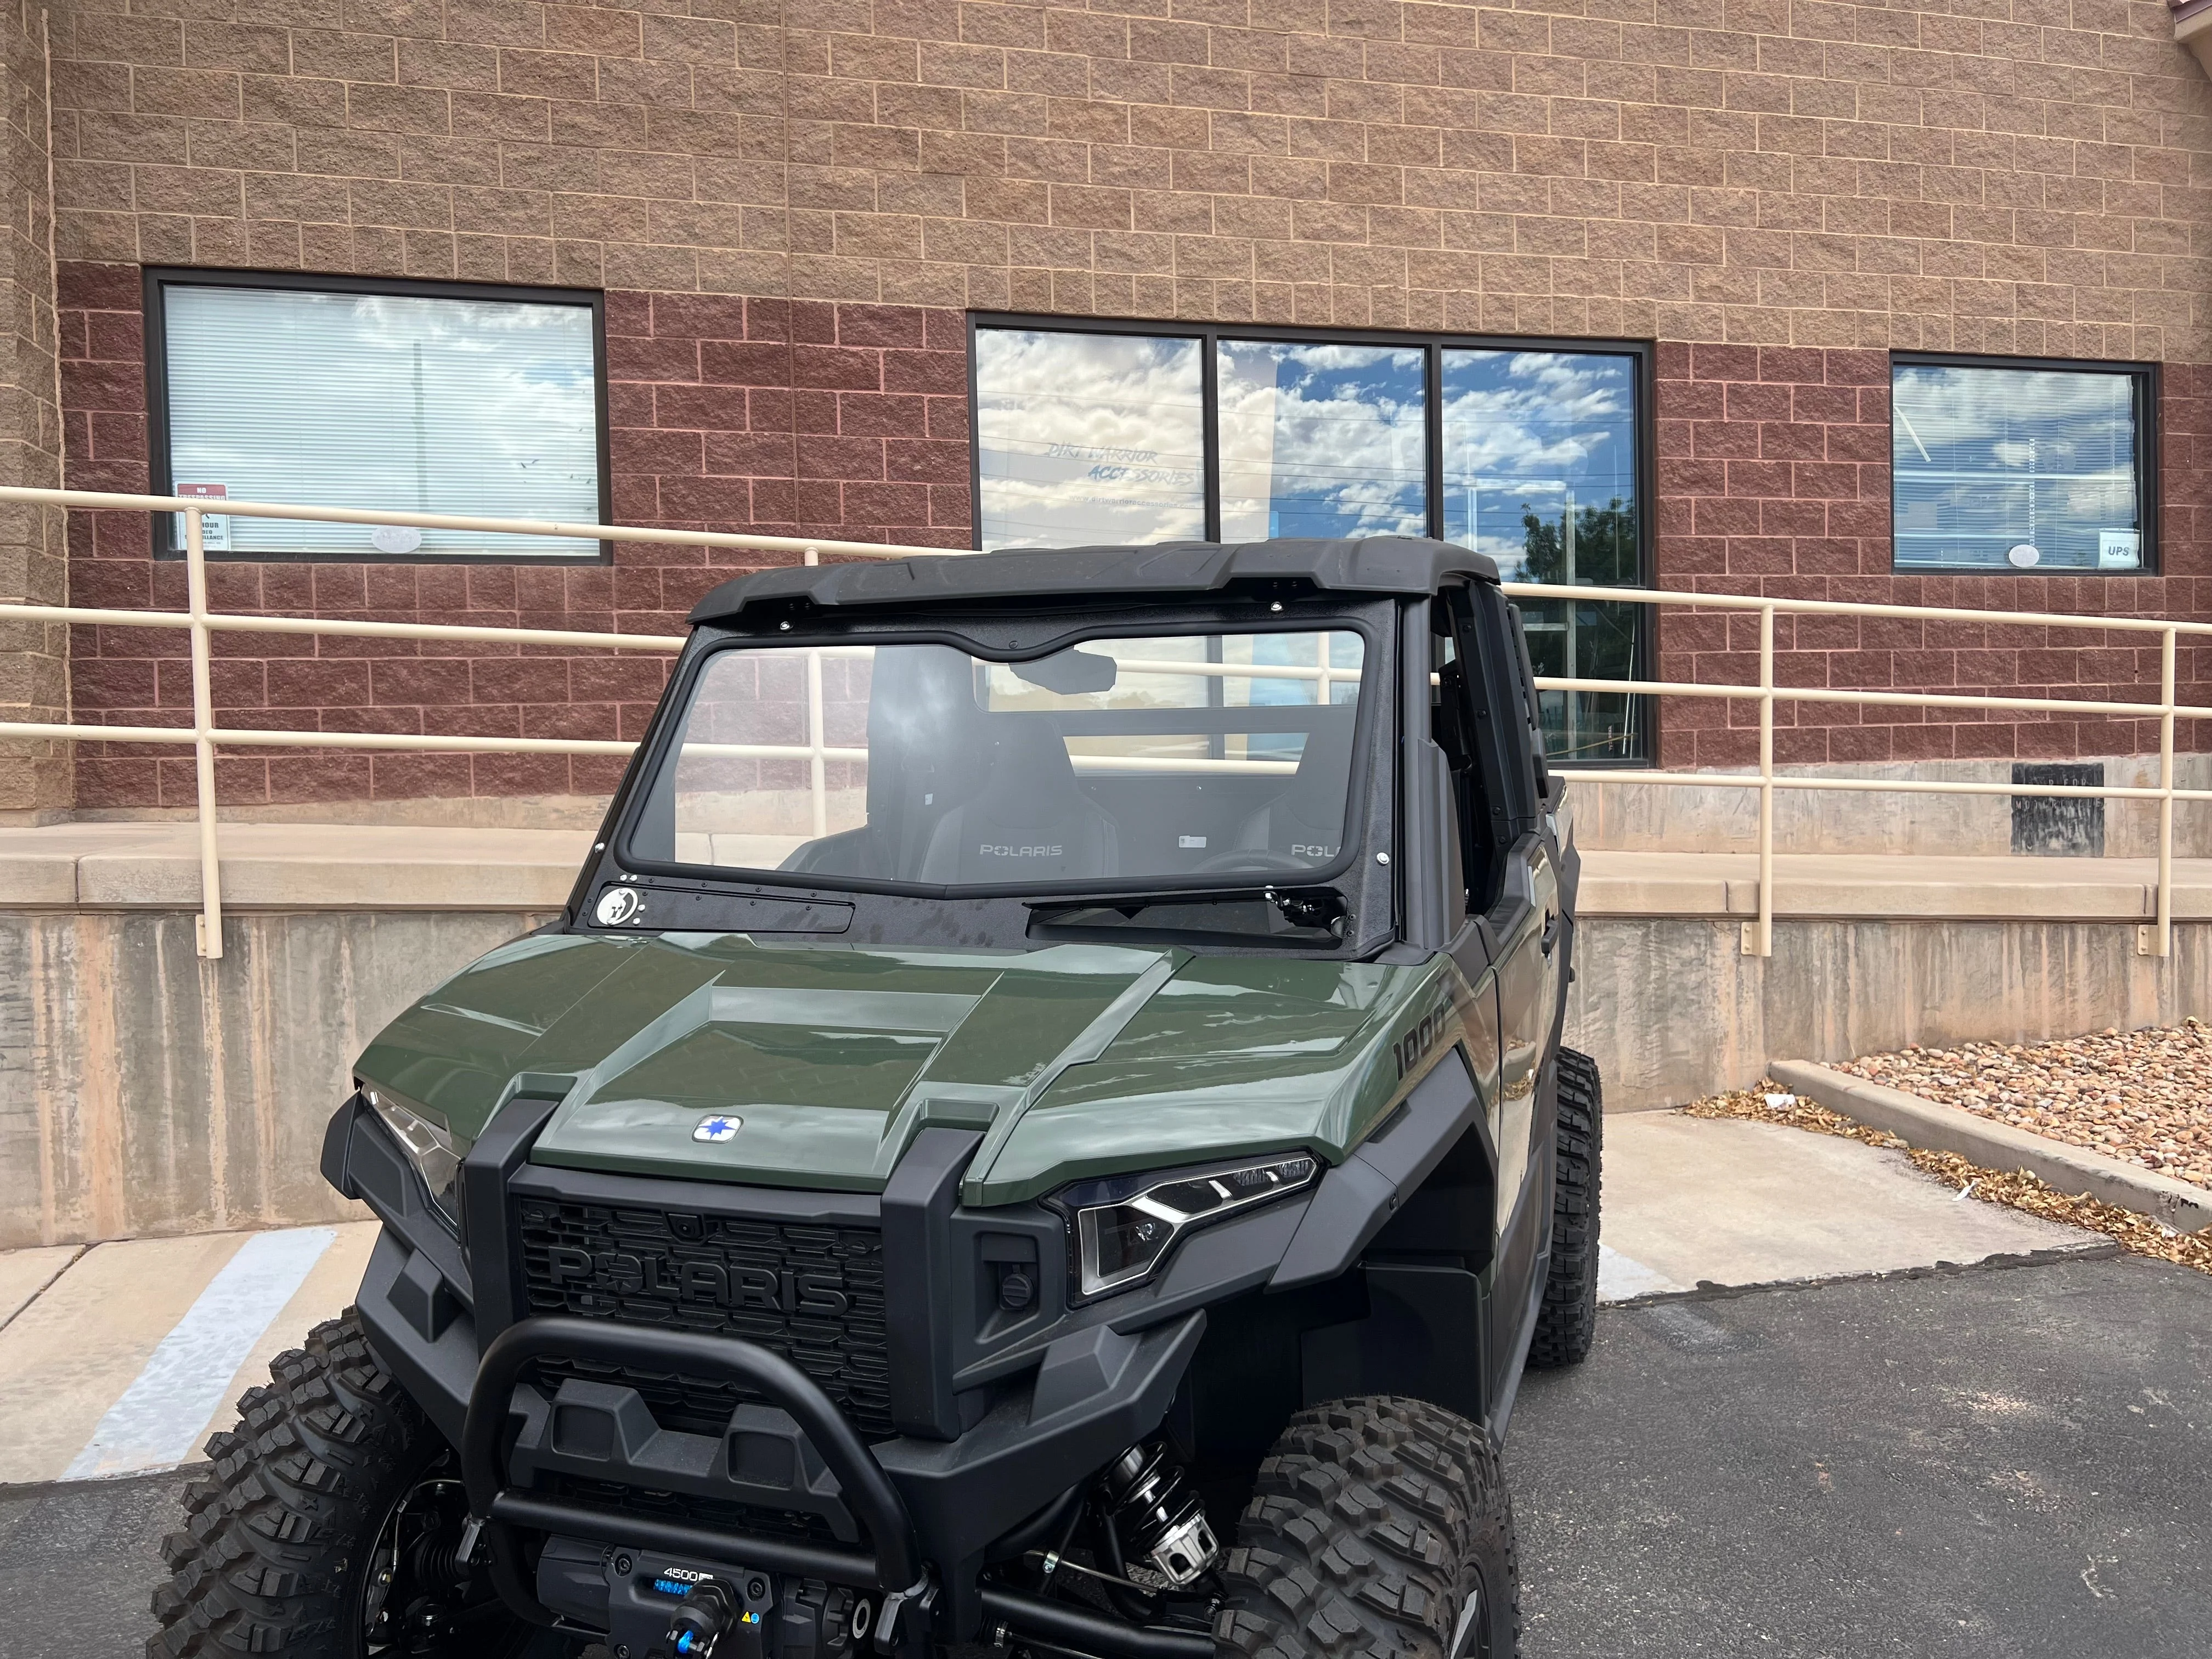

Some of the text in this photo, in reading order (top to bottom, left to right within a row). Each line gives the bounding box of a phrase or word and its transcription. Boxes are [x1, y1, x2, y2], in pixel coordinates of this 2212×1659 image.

[1044, 441, 1159, 464] DIRT WARRIOR
[1088, 465, 1195, 486] ACCESSORIES
[1069, 494, 1195, 509] www.dirtwarrioraccessories.com
[2108, 546, 2129, 556] UPS
[979, 844, 1063, 857] POLARIS
[1392, 1002, 1446, 1082] 1000
[548, 1245, 853, 1318] POLARIS
[664, 1567, 698, 1582] 4500
